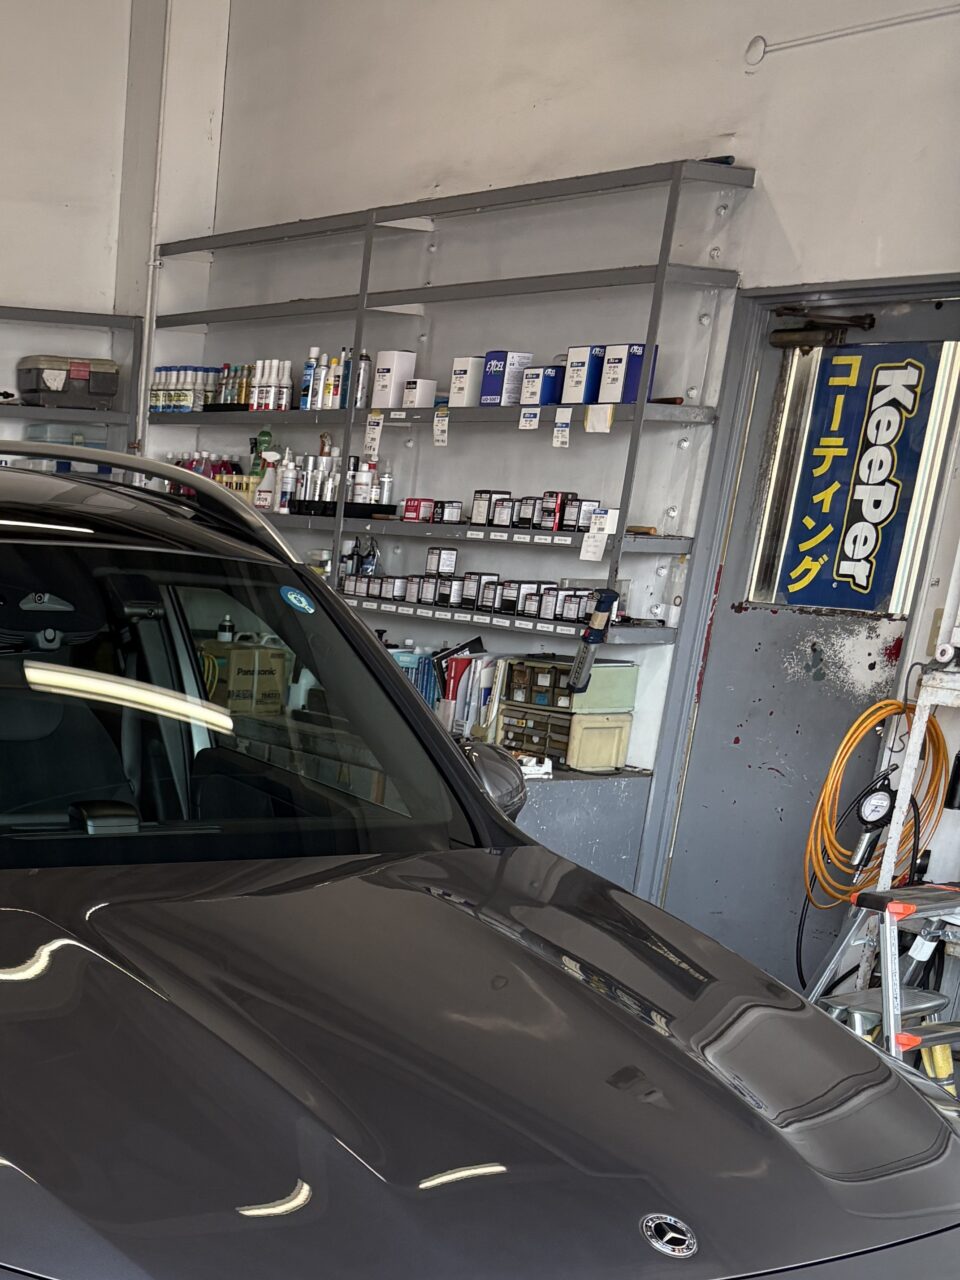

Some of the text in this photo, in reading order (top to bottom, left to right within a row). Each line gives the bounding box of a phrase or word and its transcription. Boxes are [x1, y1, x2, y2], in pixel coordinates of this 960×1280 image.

[787, 355, 863, 593] コーティング
[836, 361, 922, 590] KeePer
[236, 667, 277, 676] Panaonic
